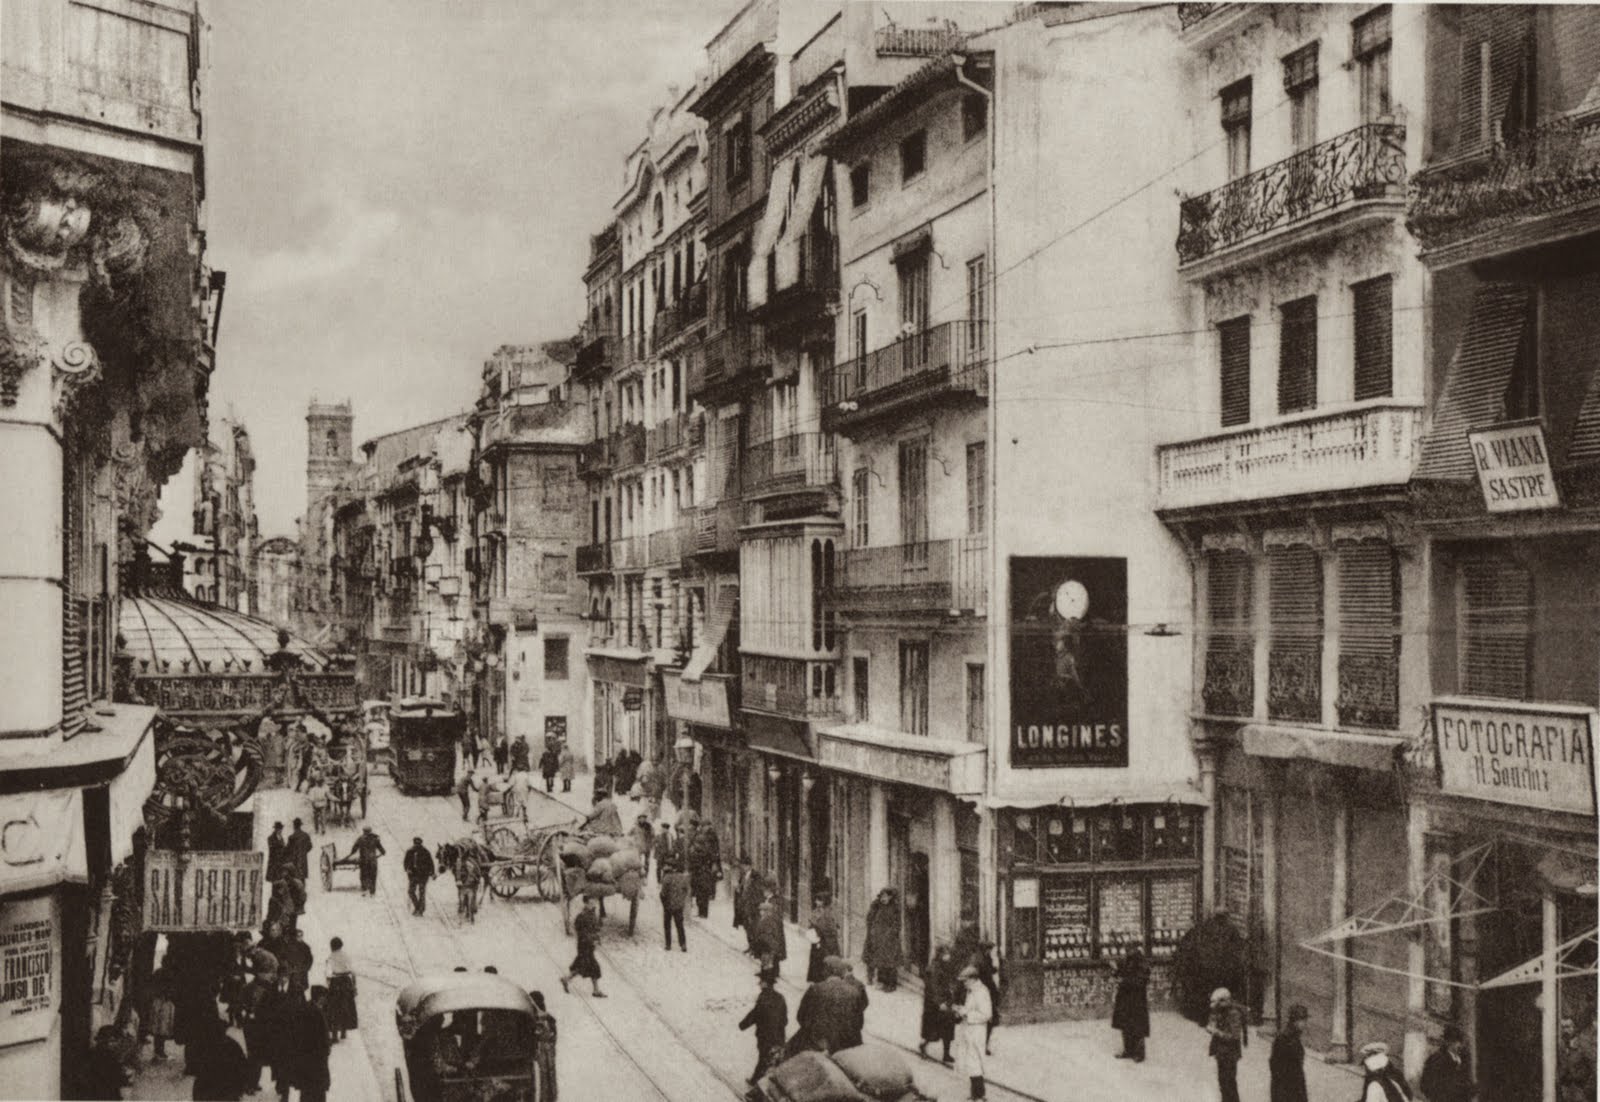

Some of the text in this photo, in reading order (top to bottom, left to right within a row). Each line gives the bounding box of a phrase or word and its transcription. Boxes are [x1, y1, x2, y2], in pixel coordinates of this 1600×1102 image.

[1490, 435, 1545, 468] VIANA
[1489, 474, 1550, 501] SASTRE
[1017, 724, 1122, 749] LONGINES
[1442, 717, 1585, 765] FOTOGRAFIA
[4, 951, 49, 982] FRANCISCO
[32, 975, 45, 996] DE
